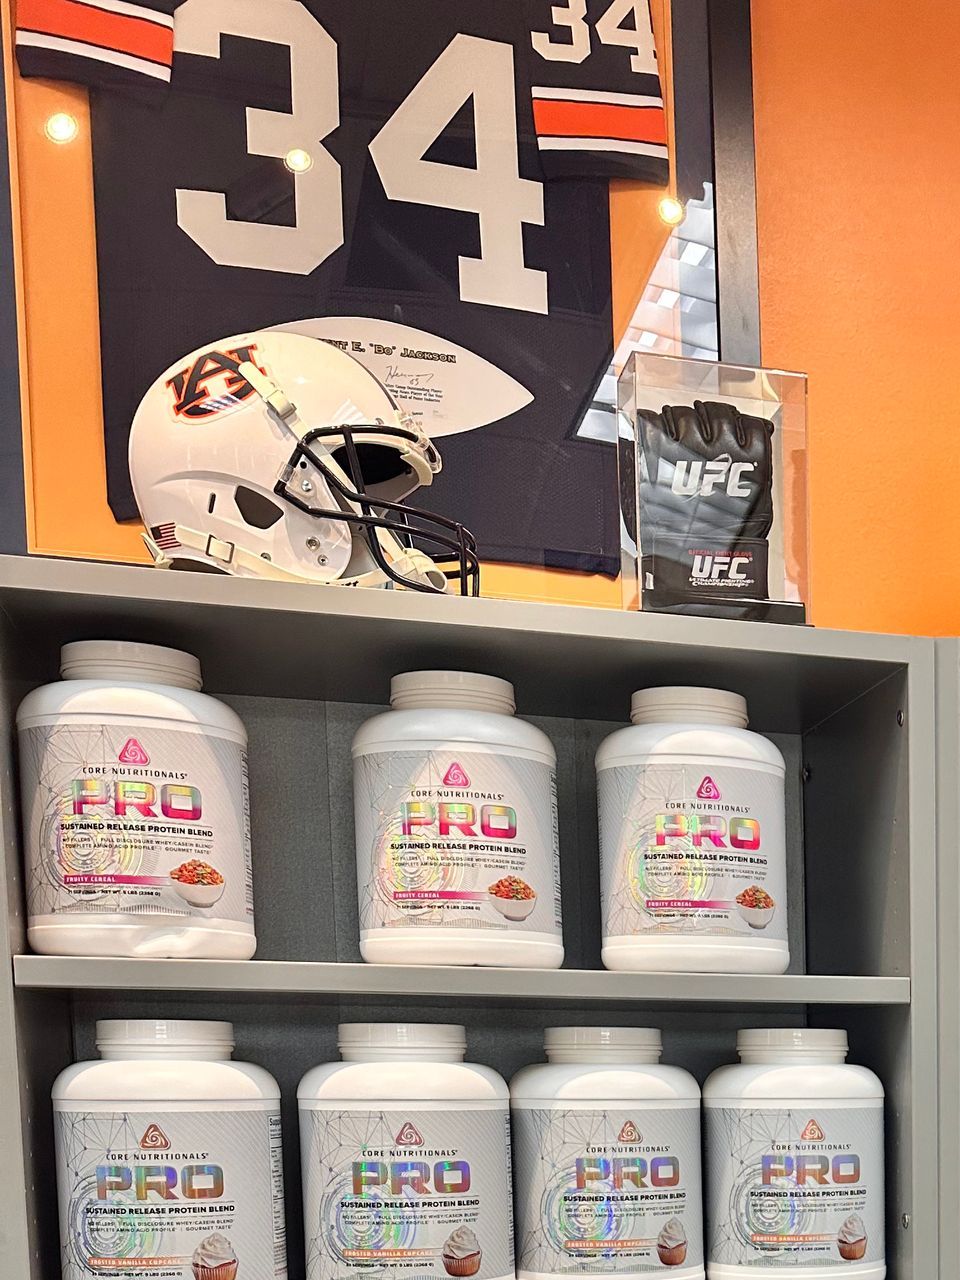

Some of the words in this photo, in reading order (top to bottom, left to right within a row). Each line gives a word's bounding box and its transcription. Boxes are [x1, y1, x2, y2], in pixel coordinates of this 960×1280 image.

[531, 0, 659, 74] 34
[174, 0, 548, 314] 34
[351, 341, 365, 352] E.
[369, 343, 396, 355] "Bo"
[400, 348, 456, 363] JACKSON
[672, 461, 754, 497] UFC
[691, 555, 750, 579] UFC
[83, 766, 107, 774] CORE
[112, 768, 186, 780] NUTRITIONALS
[71, 779, 202, 821] PRO
[437, 791, 502, 800] NUTRITIONALS
[60, 823, 105, 831] SUSTAINED
[107, 823, 146, 832] RELEASE
[148, 825, 186, 834] PROTEIN
[188, 828, 213, 837] BLEND
[401, 802, 517, 839] PRO
[655, 814, 761, 850] PRO
[433, 842, 467, 850] RELEASE
[469, 844, 502, 852] PROTEIN
[504, 846, 526, 855] BLEND
[95, 1164, 224, 1201] PRO
[352, 1161, 471, 1195] PRO
[575, 1155, 680, 1190] PRO
[761, 1154, 861, 1185] PRO
[86, 1207, 127, 1215] SUSTAINED
[129, 1207, 166, 1215] RELEASE
[168, 1206, 207, 1214] PROTEIN
[208, 1205, 235, 1213] BLEND
